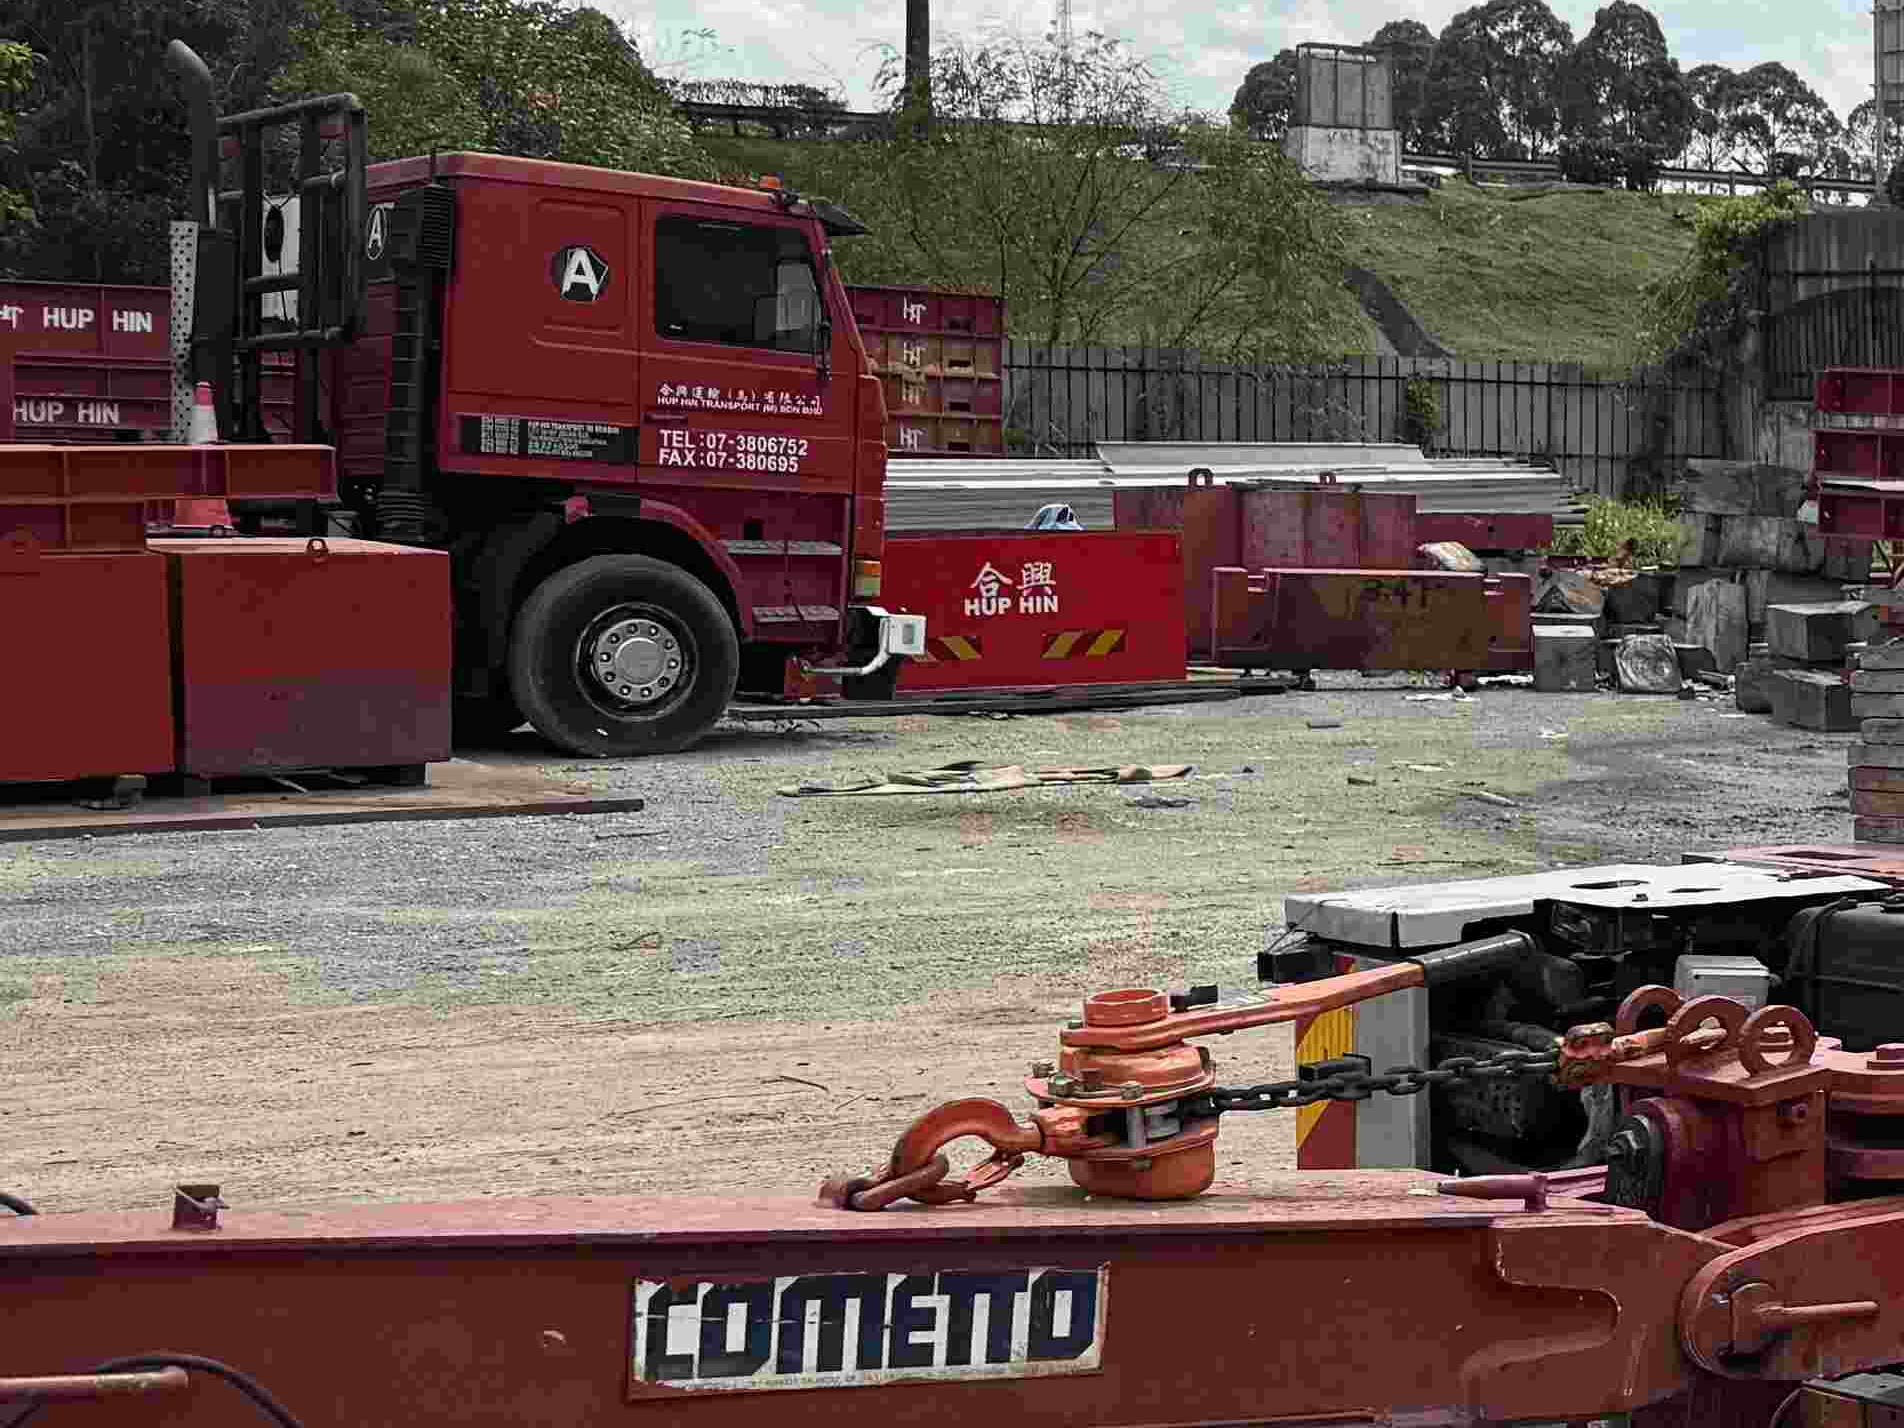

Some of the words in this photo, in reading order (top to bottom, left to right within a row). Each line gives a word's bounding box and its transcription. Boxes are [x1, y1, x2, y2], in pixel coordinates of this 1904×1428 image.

[43, 306, 95, 329] HUP
[112, 309, 152, 332] HIN
[13, 400, 64, 422] HUP
[77, 402, 120, 424] HIN
[700, 400, 761, 412] TRANSPORT
[969, 560, 1056, 597] 合興
[964, 596, 1012, 616] HUP
[1019, 595, 1059, 614] HIN
[647, 1271, 1097, 1381] COMETTO
